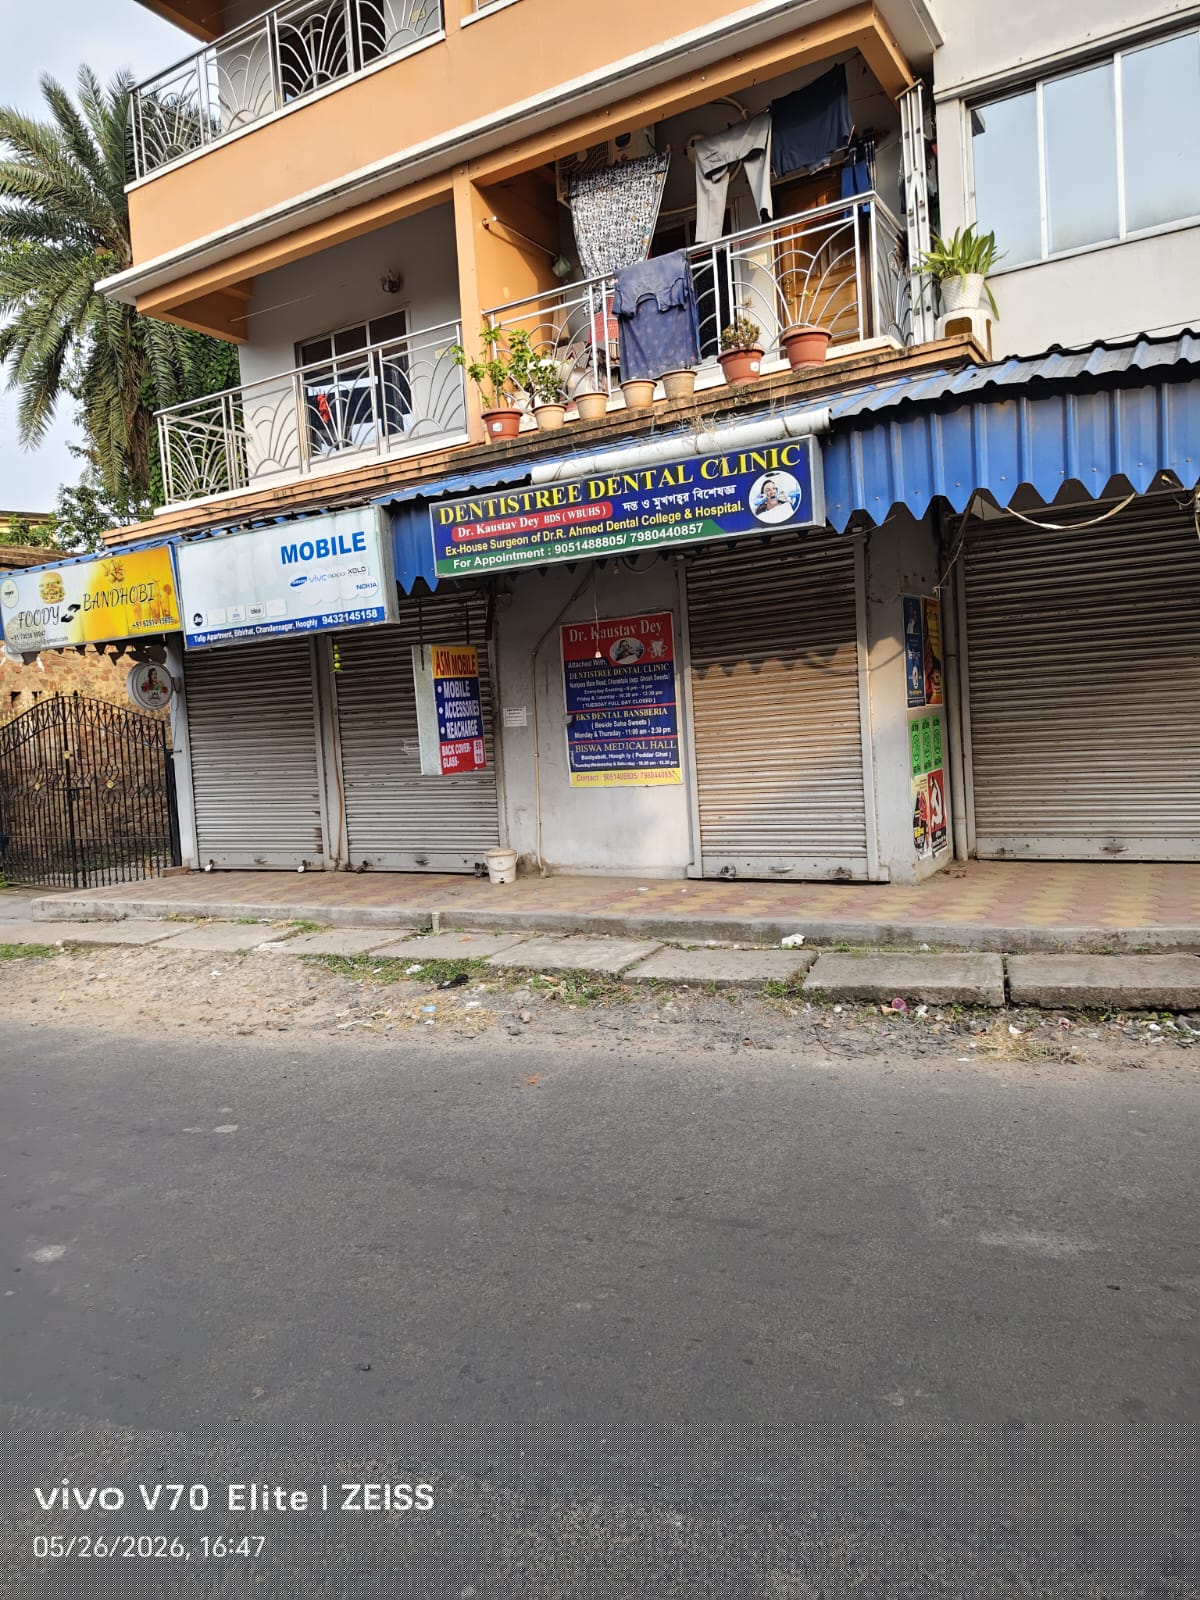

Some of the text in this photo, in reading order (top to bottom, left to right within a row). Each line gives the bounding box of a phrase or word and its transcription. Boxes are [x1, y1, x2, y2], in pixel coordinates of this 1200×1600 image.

[440, 444, 800, 524] DENTISTREE DENTAL CLINIC
[642, 499, 650, 508] ও
[445, 500, 744, 556] Ex-House Surgeon of Dr.R. Ahmed Dental College & Hospital.
[457, 526, 474, 538] Dr.
[476, 520, 516, 535] Kaustav
[519, 515, 539, 528] Dey
[543, 514, 561, 525] BDS
[568, 507, 600, 520] WBUHS
[280, 530, 367, 565] MOBILE
[453, 557, 471, 569] For
[474, 547, 544, 567] Appointment
[554, 533, 627, 553] 9051488805/
[631, 523, 704, 543] 7980440857
[83, 582, 156, 612] BANDHOBI
[356, 582, 377, 591] NOKIA
[18, 605, 60, 629] FOODY
[194, 634, 206, 643] Tulip
[295, 618, 318, 630] Hooghly
[322, 608, 378, 625] 9432145158
[569, 619, 663, 642] Dr. Kaustav Dey
[436, 650, 476, 676] ASM MOBILE
[569, 662, 670, 681] DENTISTREE DENTAL CLINIC
[443, 680, 471, 698] MOBILE
[445, 699, 480, 719] ACCESSORIES
[591, 710, 622, 721] DENTAL
[624, 707, 668, 719] BANSBERIA
[446, 719, 479, 739] REACHARGE
[574, 731, 594, 740] Monday
[599, 728, 621, 738] Thursday
[441, 744, 455, 756] BACK
[575, 743, 602, 753] BISWA
[650, 740, 677, 749] HALL
